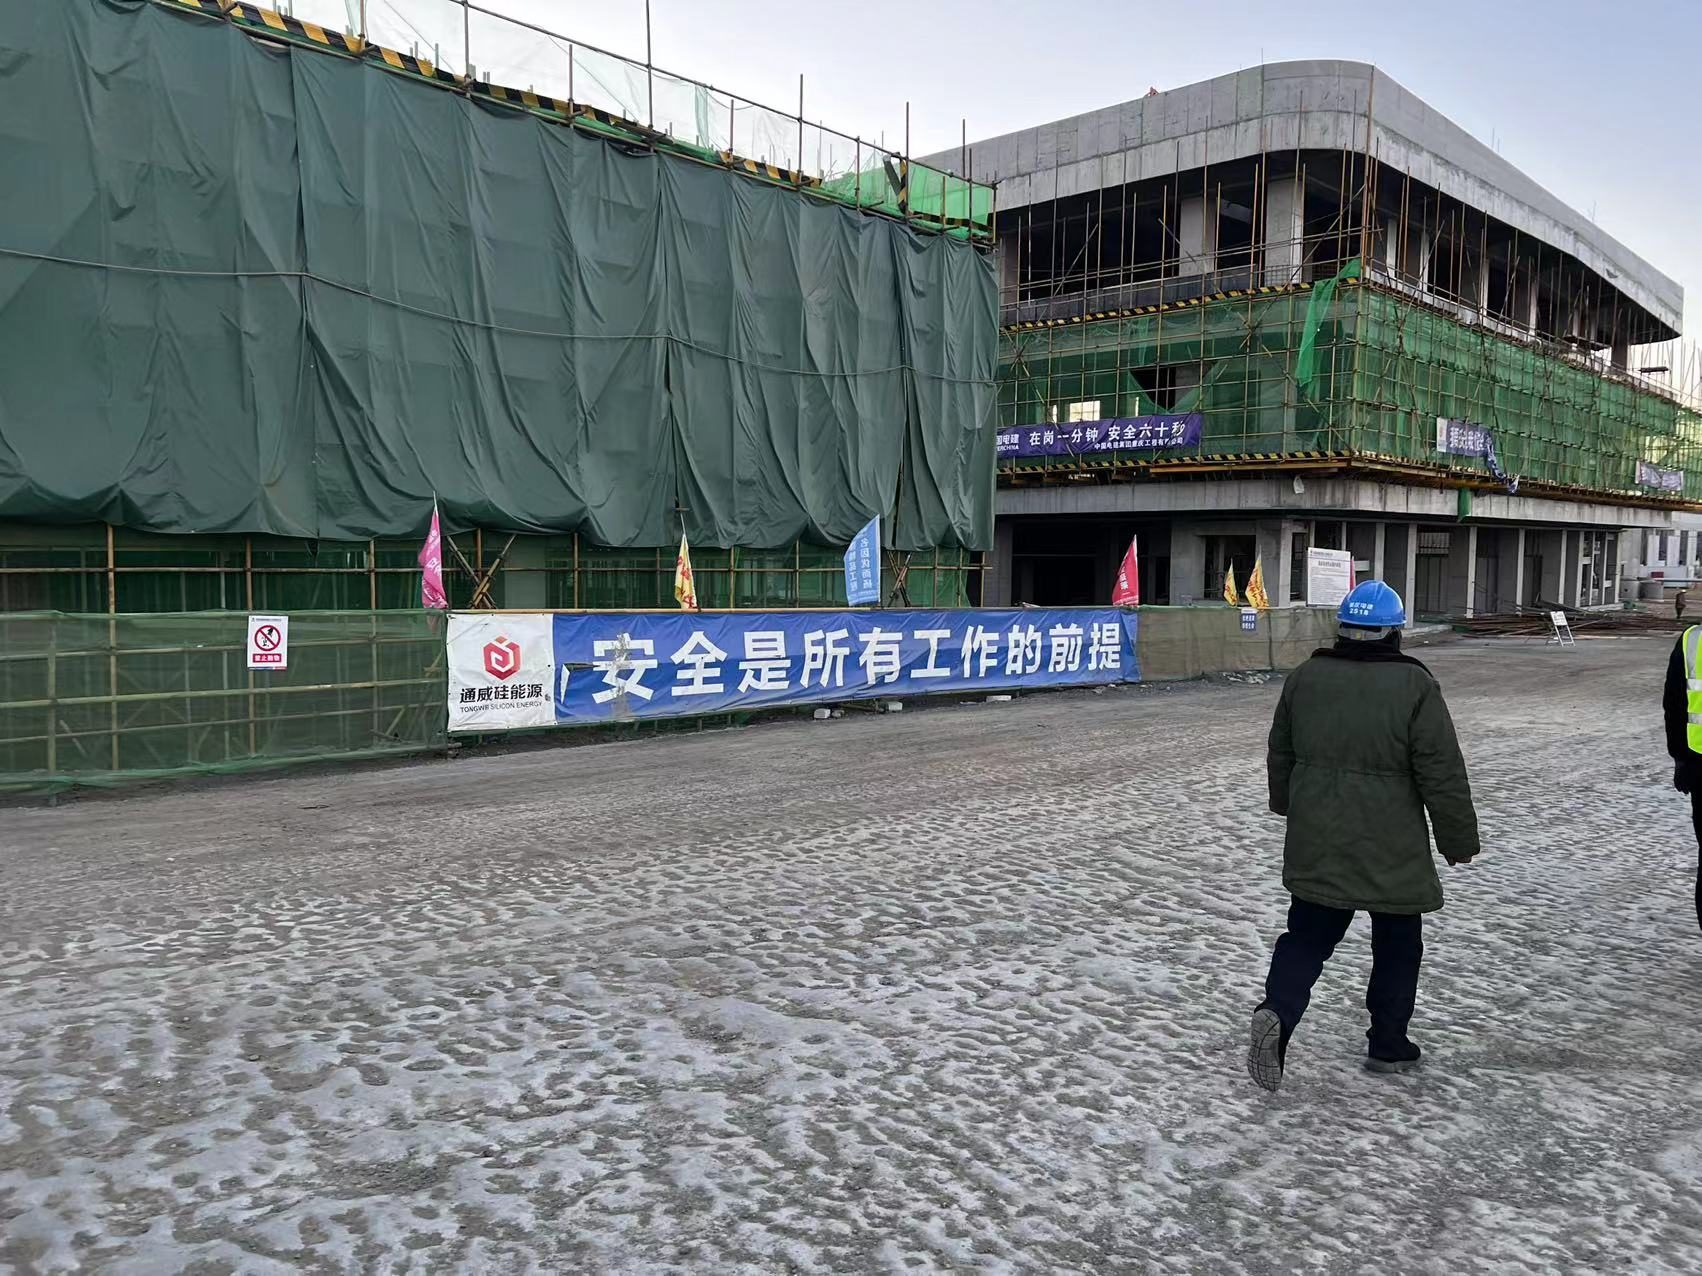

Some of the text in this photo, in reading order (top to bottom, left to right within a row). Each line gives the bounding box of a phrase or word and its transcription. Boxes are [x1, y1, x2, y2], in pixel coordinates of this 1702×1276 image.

[1029, 420, 1186, 446] 在岗一分钟 安全六十秒
[592, 622, 1122, 704] 安全是所有工作的前提
[459, 683, 544, 704] 通威硅能源
[490, 702, 515, 710] SILICON
[516, 700, 543, 709] ENERGY
